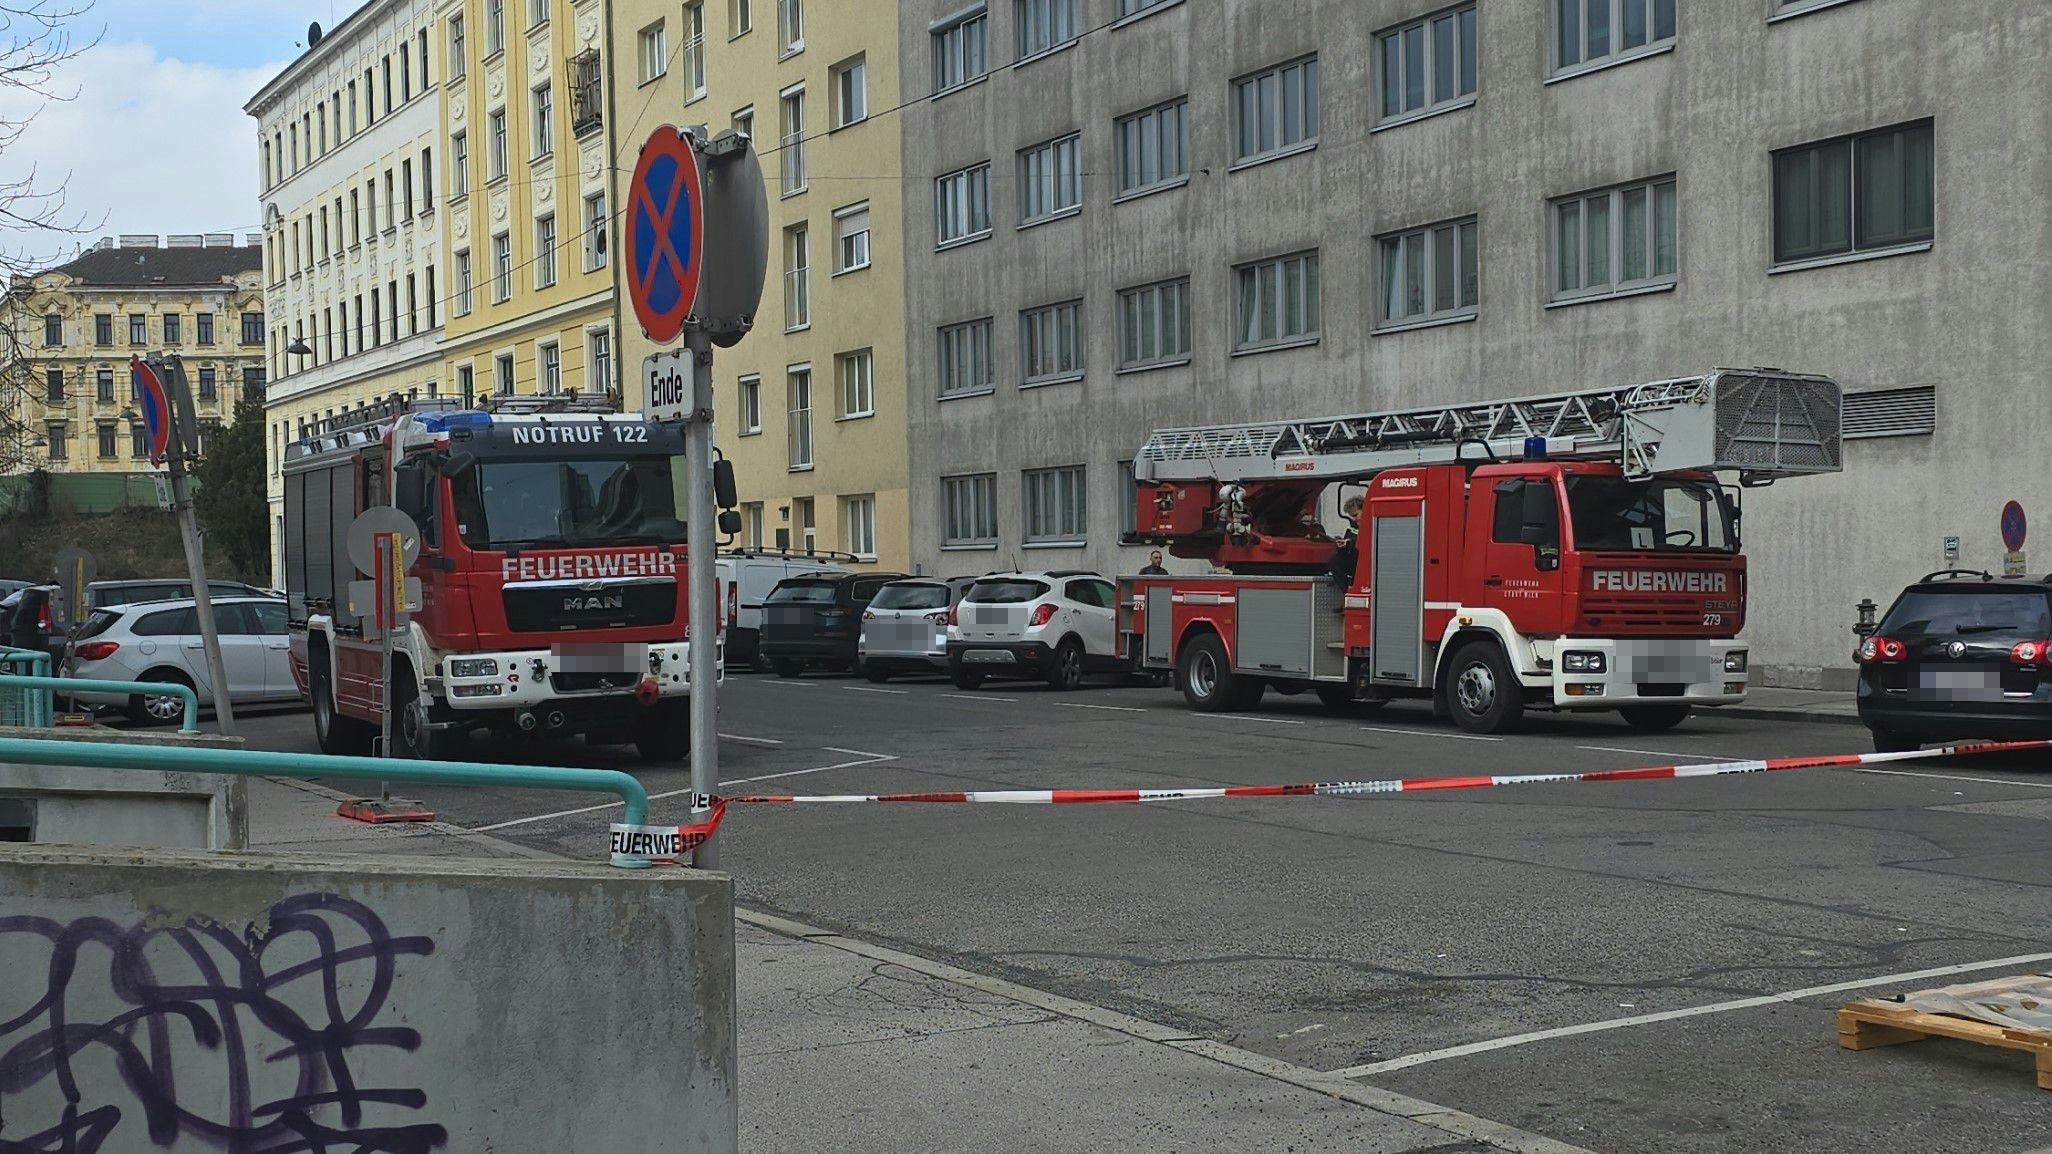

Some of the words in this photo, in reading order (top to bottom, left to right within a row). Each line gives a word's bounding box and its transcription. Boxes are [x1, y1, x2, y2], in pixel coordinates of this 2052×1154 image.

[651, 367, 682, 407] Ende
[512, 426, 604, 444] NOTRUF
[613, 426, 648, 443] 122
[1382, 477, 1418, 488] MAGIRUS
[502, 552, 676, 581] FEUERWEHR
[1592, 570, 1727, 592] FEUERWEHR
[563, 596, 623, 611] MAN
[1703, 613, 1721, 626] 279
[609, 831, 707, 854] EUERWEHR
